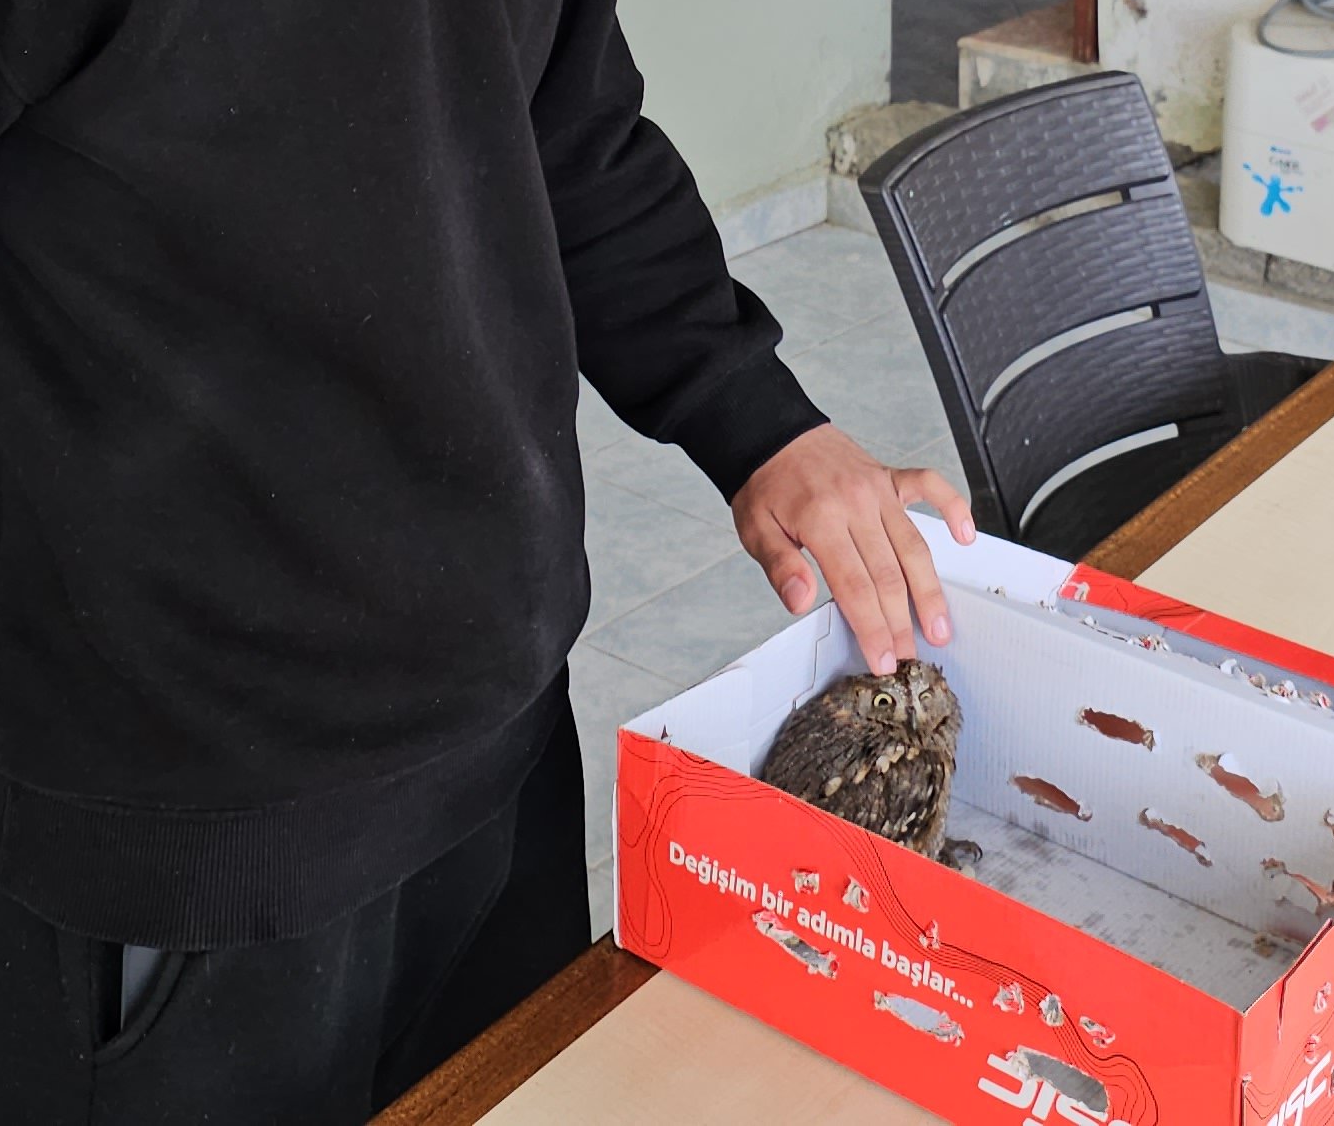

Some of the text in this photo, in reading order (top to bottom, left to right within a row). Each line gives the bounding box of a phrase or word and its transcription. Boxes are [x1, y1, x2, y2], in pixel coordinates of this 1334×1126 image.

[669, 841, 974, 1009] Değişim bir adımla başlar...
